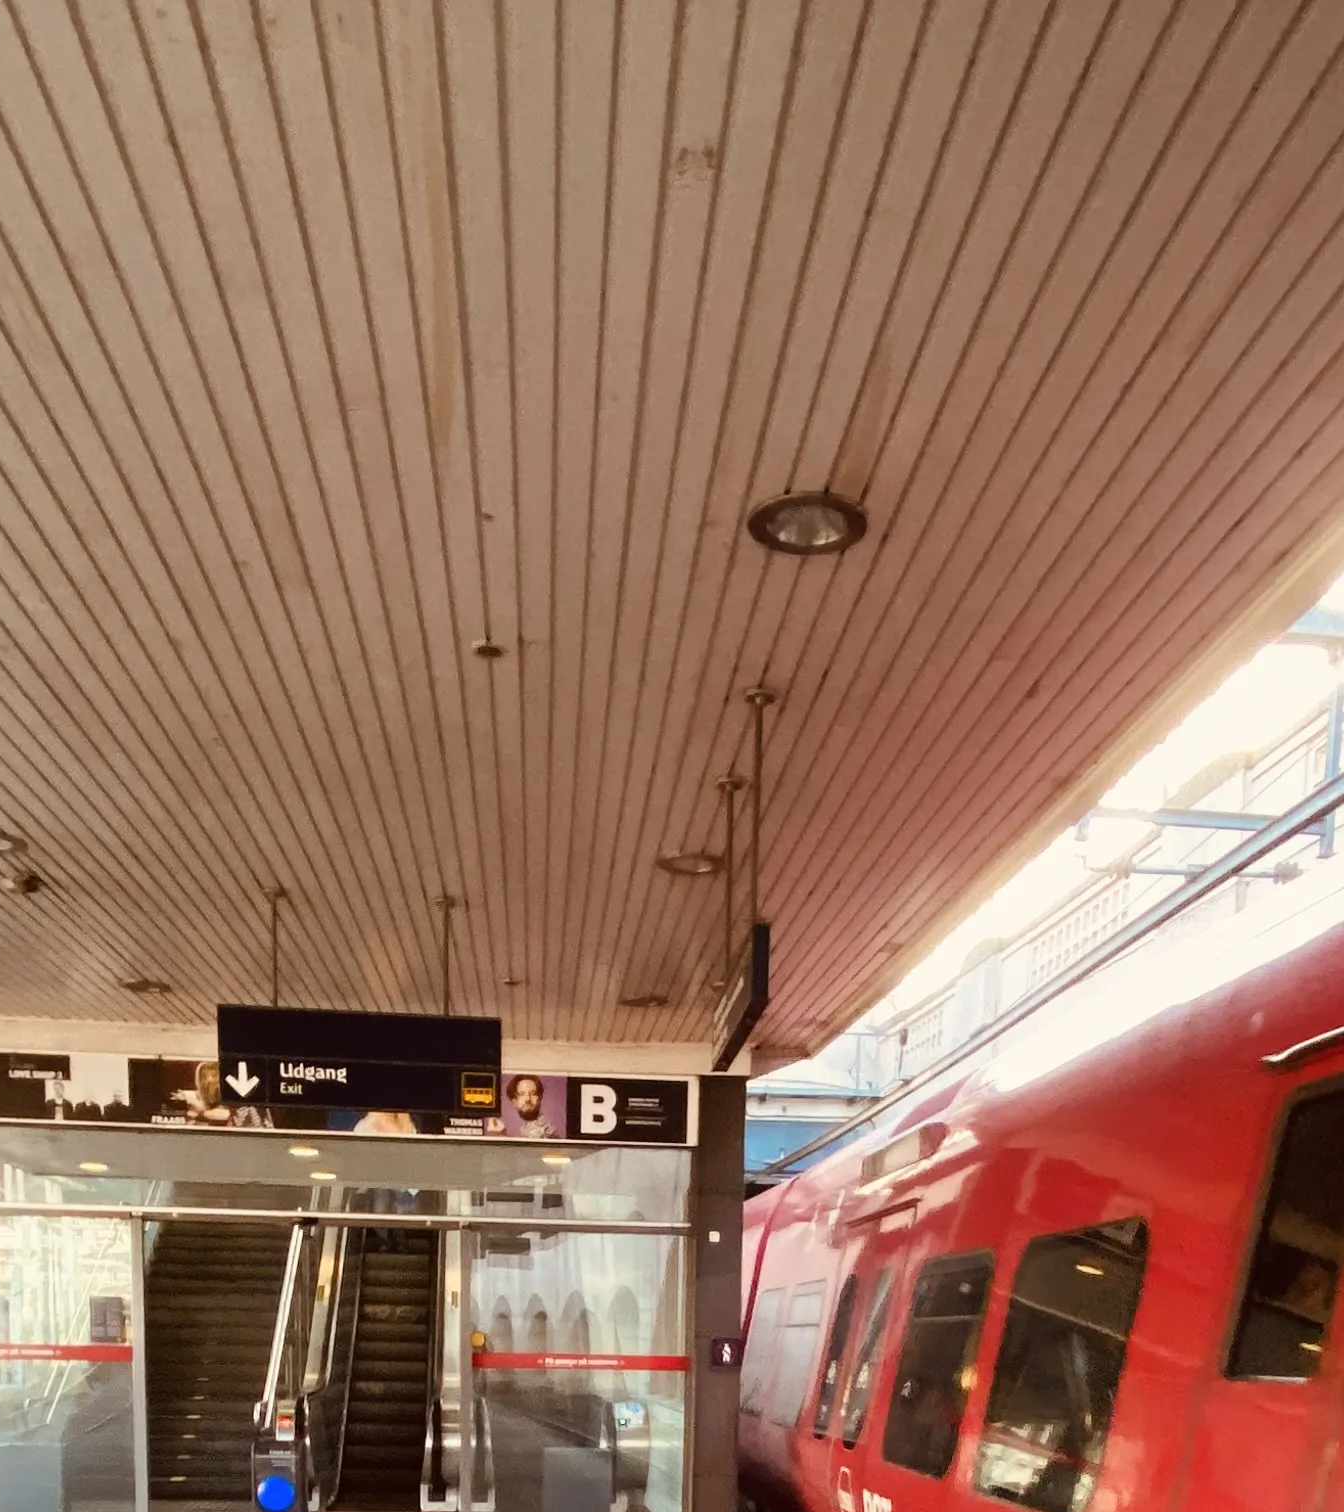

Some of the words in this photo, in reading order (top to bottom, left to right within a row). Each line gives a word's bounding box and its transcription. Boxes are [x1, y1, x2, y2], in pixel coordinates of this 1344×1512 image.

[279, 1062, 348, 1083] Udgang
[280, 1082, 303, 1095] Exit
[580, 1083, 618, 1134] B
